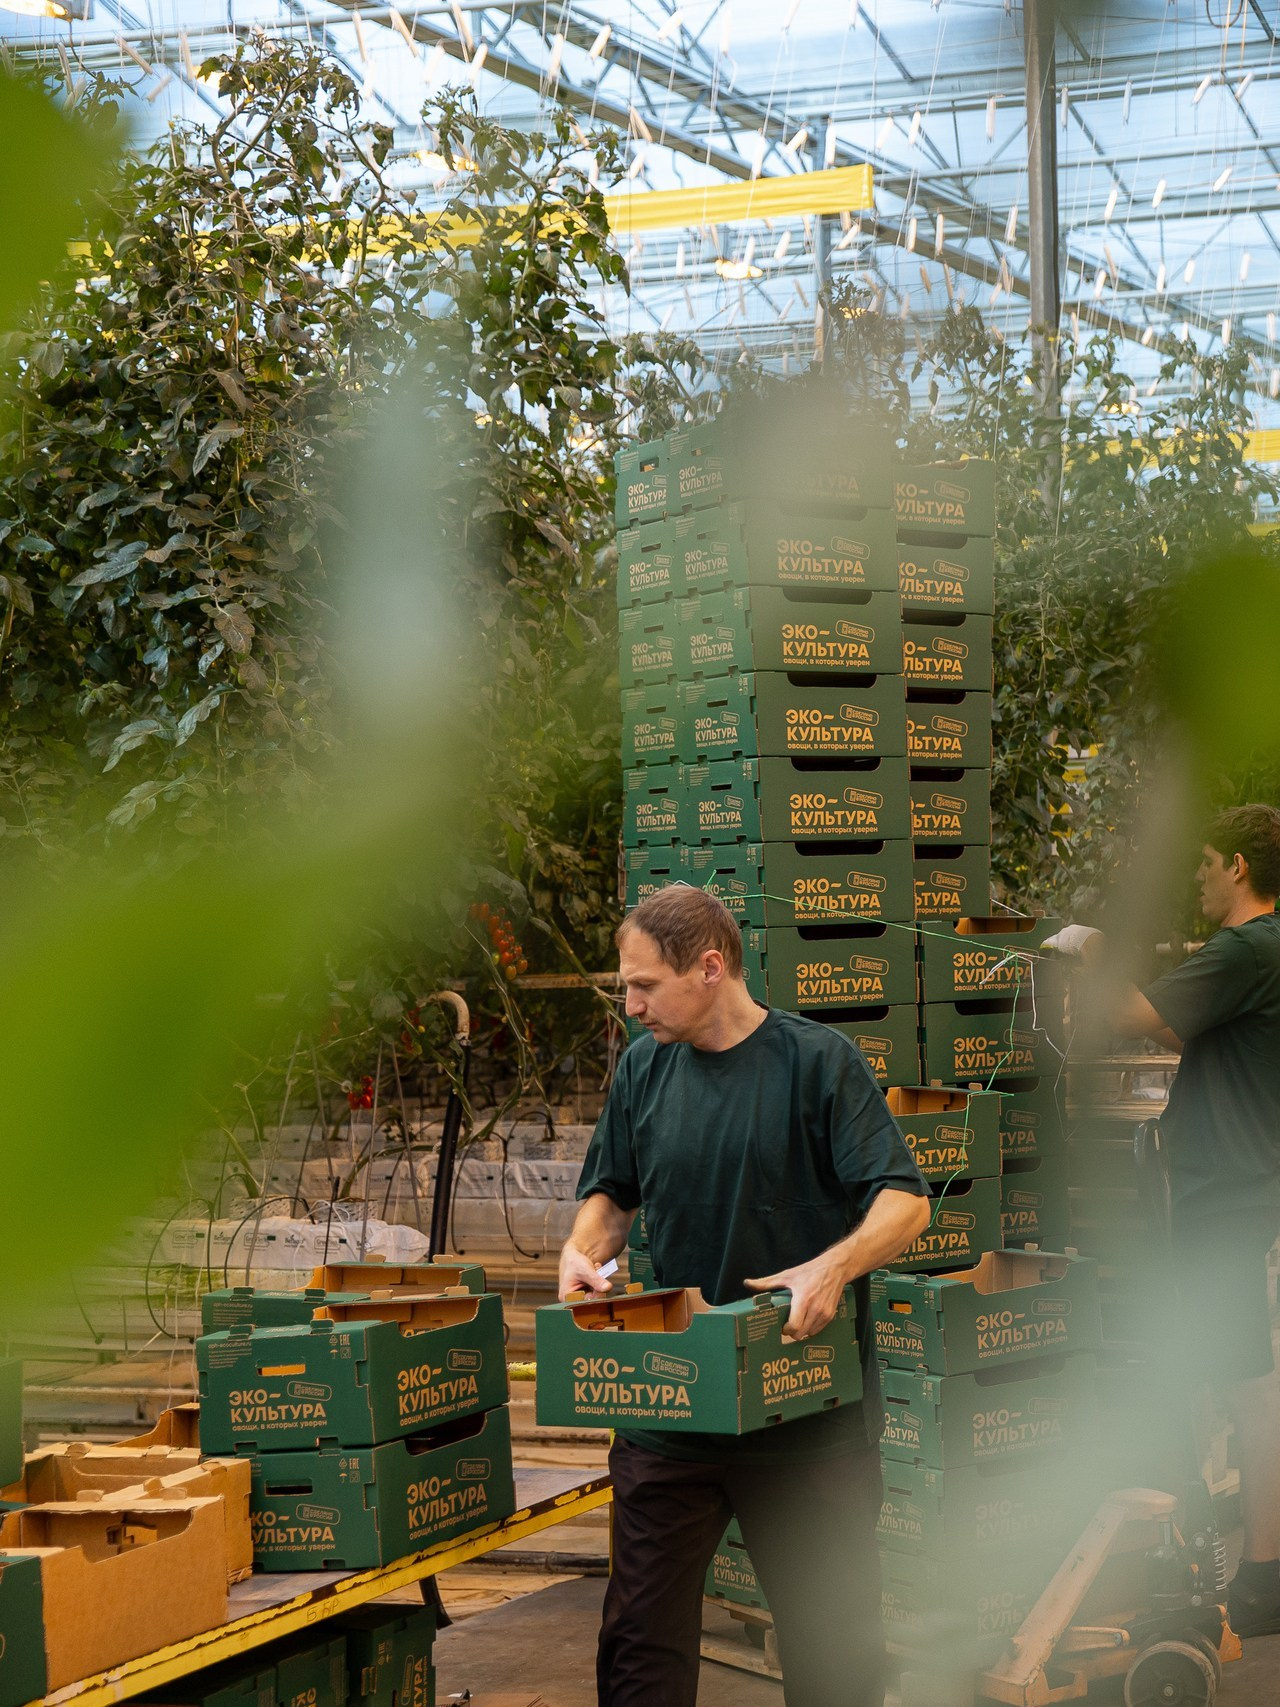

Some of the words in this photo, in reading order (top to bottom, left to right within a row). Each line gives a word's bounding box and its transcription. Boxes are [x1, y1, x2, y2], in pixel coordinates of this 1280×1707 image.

[896, 482, 928, 497] КО-
[896, 498, 964, 517] УЛЬТУРА
[685, 556, 727, 575] КУЛЬТУРА
[778, 556, 864, 575] КУЛЬТУРА
[630, 568, 669, 587] КУЛЬТУРА
[898, 577, 963, 595] УЛЬТУРА
[691, 641, 732, 659] КУЛЬТУРА
[783, 641, 869, 658] КУЛЬТУРА
[904, 640, 926, 654] О-
[815, 658, 844, 666] которых
[904, 656, 962, 672] ЛЬТУРА
[634, 732, 674, 747] КУЛЬТУРА
[695, 726, 737, 742] КУЛЬТУРА
[787, 726, 873, 741] КУЛЬТУРА
[636, 813, 676, 827] КУЛЬТУРА
[699, 811, 741, 824] КУЛЬТУРА
[791, 810, 877, 826] КУЛЬТУРА
[912, 814, 960, 828] ЬТУРА
[795, 893, 880, 911] КУЛЬТУРА
[954, 966, 1034, 983] КУЛЬТУРА
[797, 976, 883, 996] КУЛЬТУРА
[955, 1049, 1035, 1069] КУЛЬТУРА
[905, 1134, 929, 1149] О-
[1000, 1130, 1036, 1146] ТУРА
[912, 1147, 968, 1165] ЬТУРА
[1000, 1210, 1038, 1227] ТУРА
[904, 1232, 969, 1253] ЛЬТУРА
[876, 1333, 923, 1351] КУЛЬТУРА
[977, 1317, 1067, 1349] КУЛЬТУРА
[763, 1364, 830, 1396] КУЛЬТУРА
[399, 1373, 478, 1415] КУЛЬТУРА
[574, 1382, 690, 1406] КУЛЬТУРА
[231, 1402, 326, 1423] КУЛЬТУРА
[400, 1413, 422, 1425] овощи,
[428, 1404, 454, 1417] которых
[456, 1397, 479, 1411] уверен
[575, 1406, 607, 1415] овощи,
[617, 1408, 655, 1418] которых
[658, 1410, 691, 1419] уверен
[884, 1426, 920, 1443] ЛЬТУРА
[408, 1481, 487, 1529] КУЛЬТУРА
[880, 1515, 921, 1534] УЛЬТУРА
[251, 1527, 334, 1544] УЛЬТУРА
